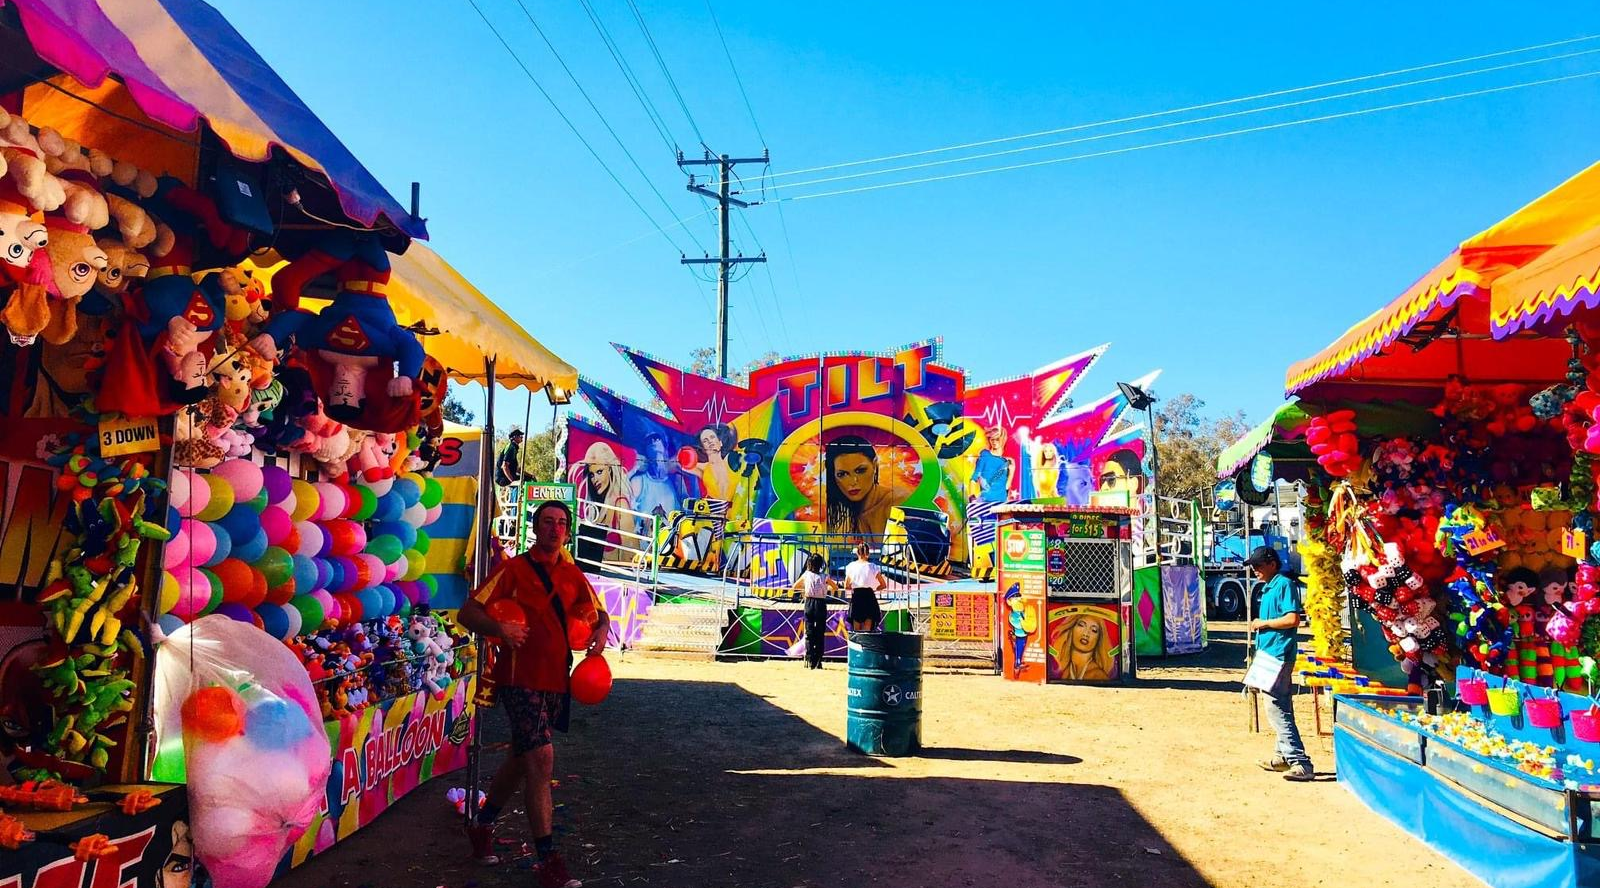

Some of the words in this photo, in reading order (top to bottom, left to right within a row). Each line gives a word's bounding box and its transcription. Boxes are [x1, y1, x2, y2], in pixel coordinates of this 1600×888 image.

[777, 344, 937, 419] TILT
[103, 431, 112, 446] 3
[115, 425, 155, 444] DOWN
[533, 487, 567, 499] ENTRY
[697, 503, 706, 511] 6
[1072, 524, 1083, 535] for
[1084, 523, 1098, 537] $15
[1007, 539, 1025, 554] STOP
[1049, 539, 1062, 550] $8
[1049, 576, 1063, 585] $20
[341, 747, 362, 806] A
[364, 709, 447, 791] BALLOON
